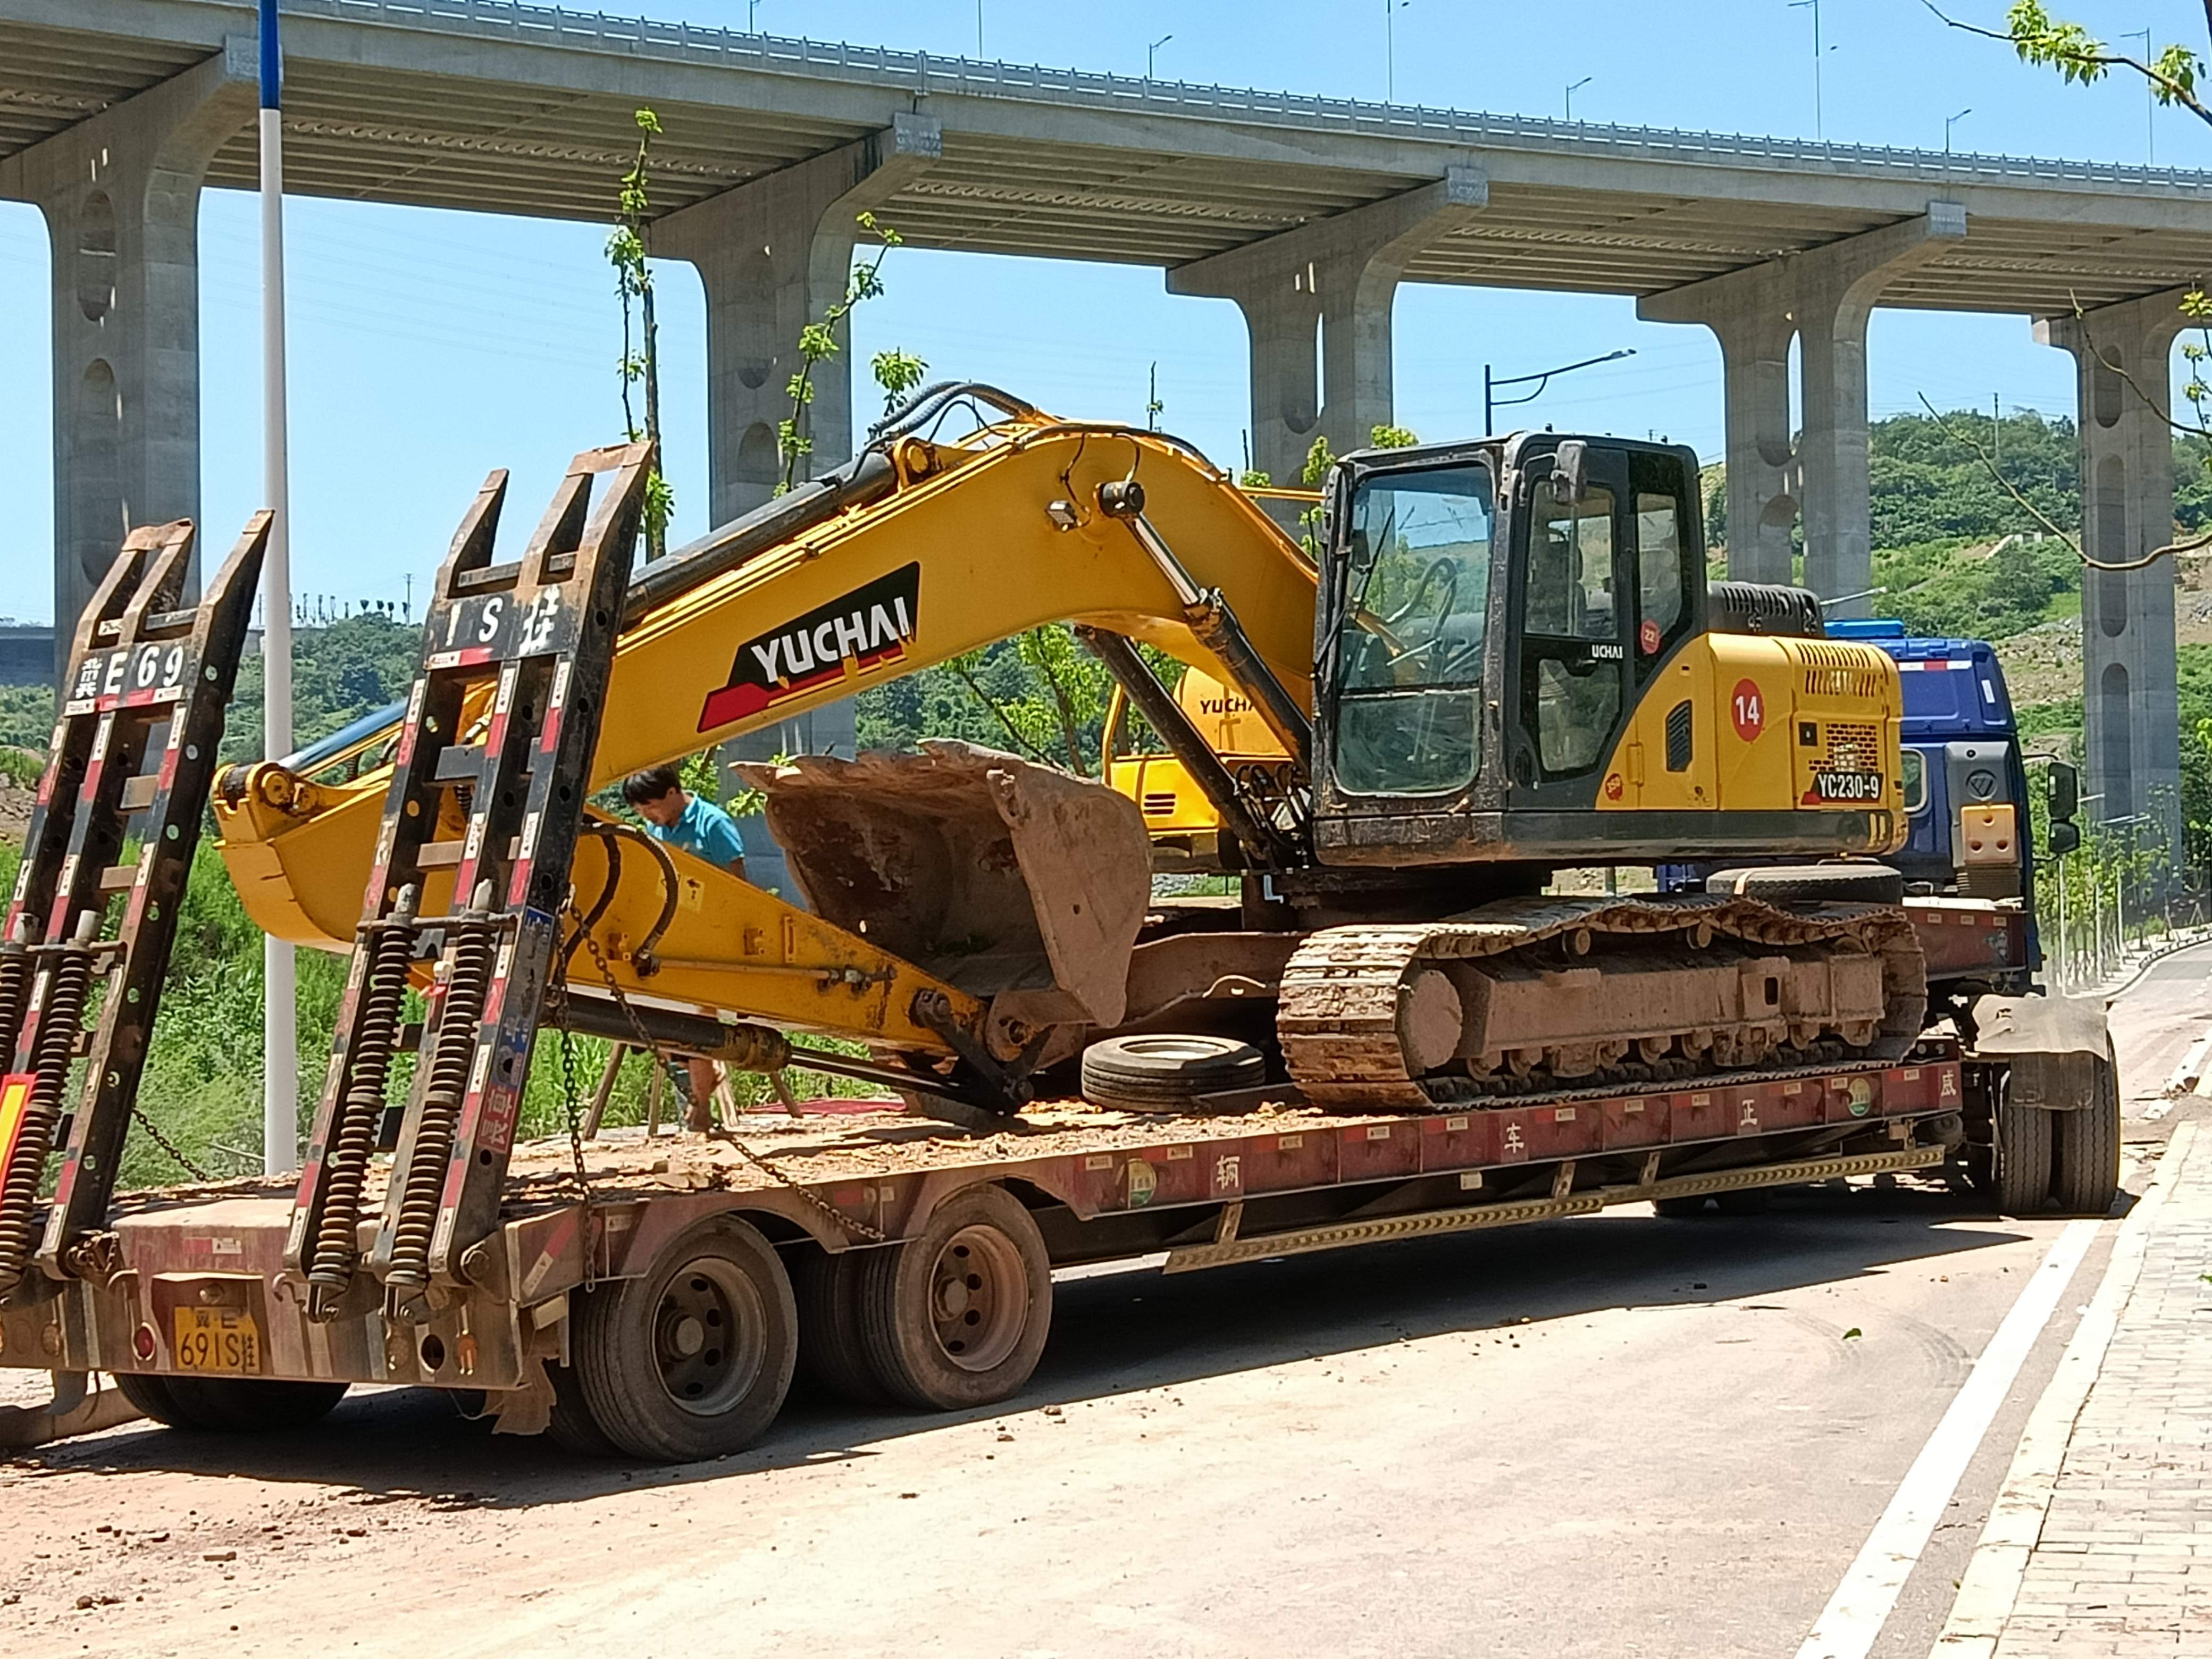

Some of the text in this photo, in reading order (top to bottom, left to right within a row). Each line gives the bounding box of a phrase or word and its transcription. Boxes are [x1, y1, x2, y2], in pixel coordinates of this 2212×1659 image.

[751, 596, 911, 683] YUCHAI
[1200, 696, 1253, 715] YUCH
[1735, 695, 1760, 725] 14
[1817, 773, 1879, 799] YC230-9
[1740, 1099, 1758, 1127] 正
[1504, 1121, 1524, 1154] 车
[1216, 1154, 1240, 1190] 辆
